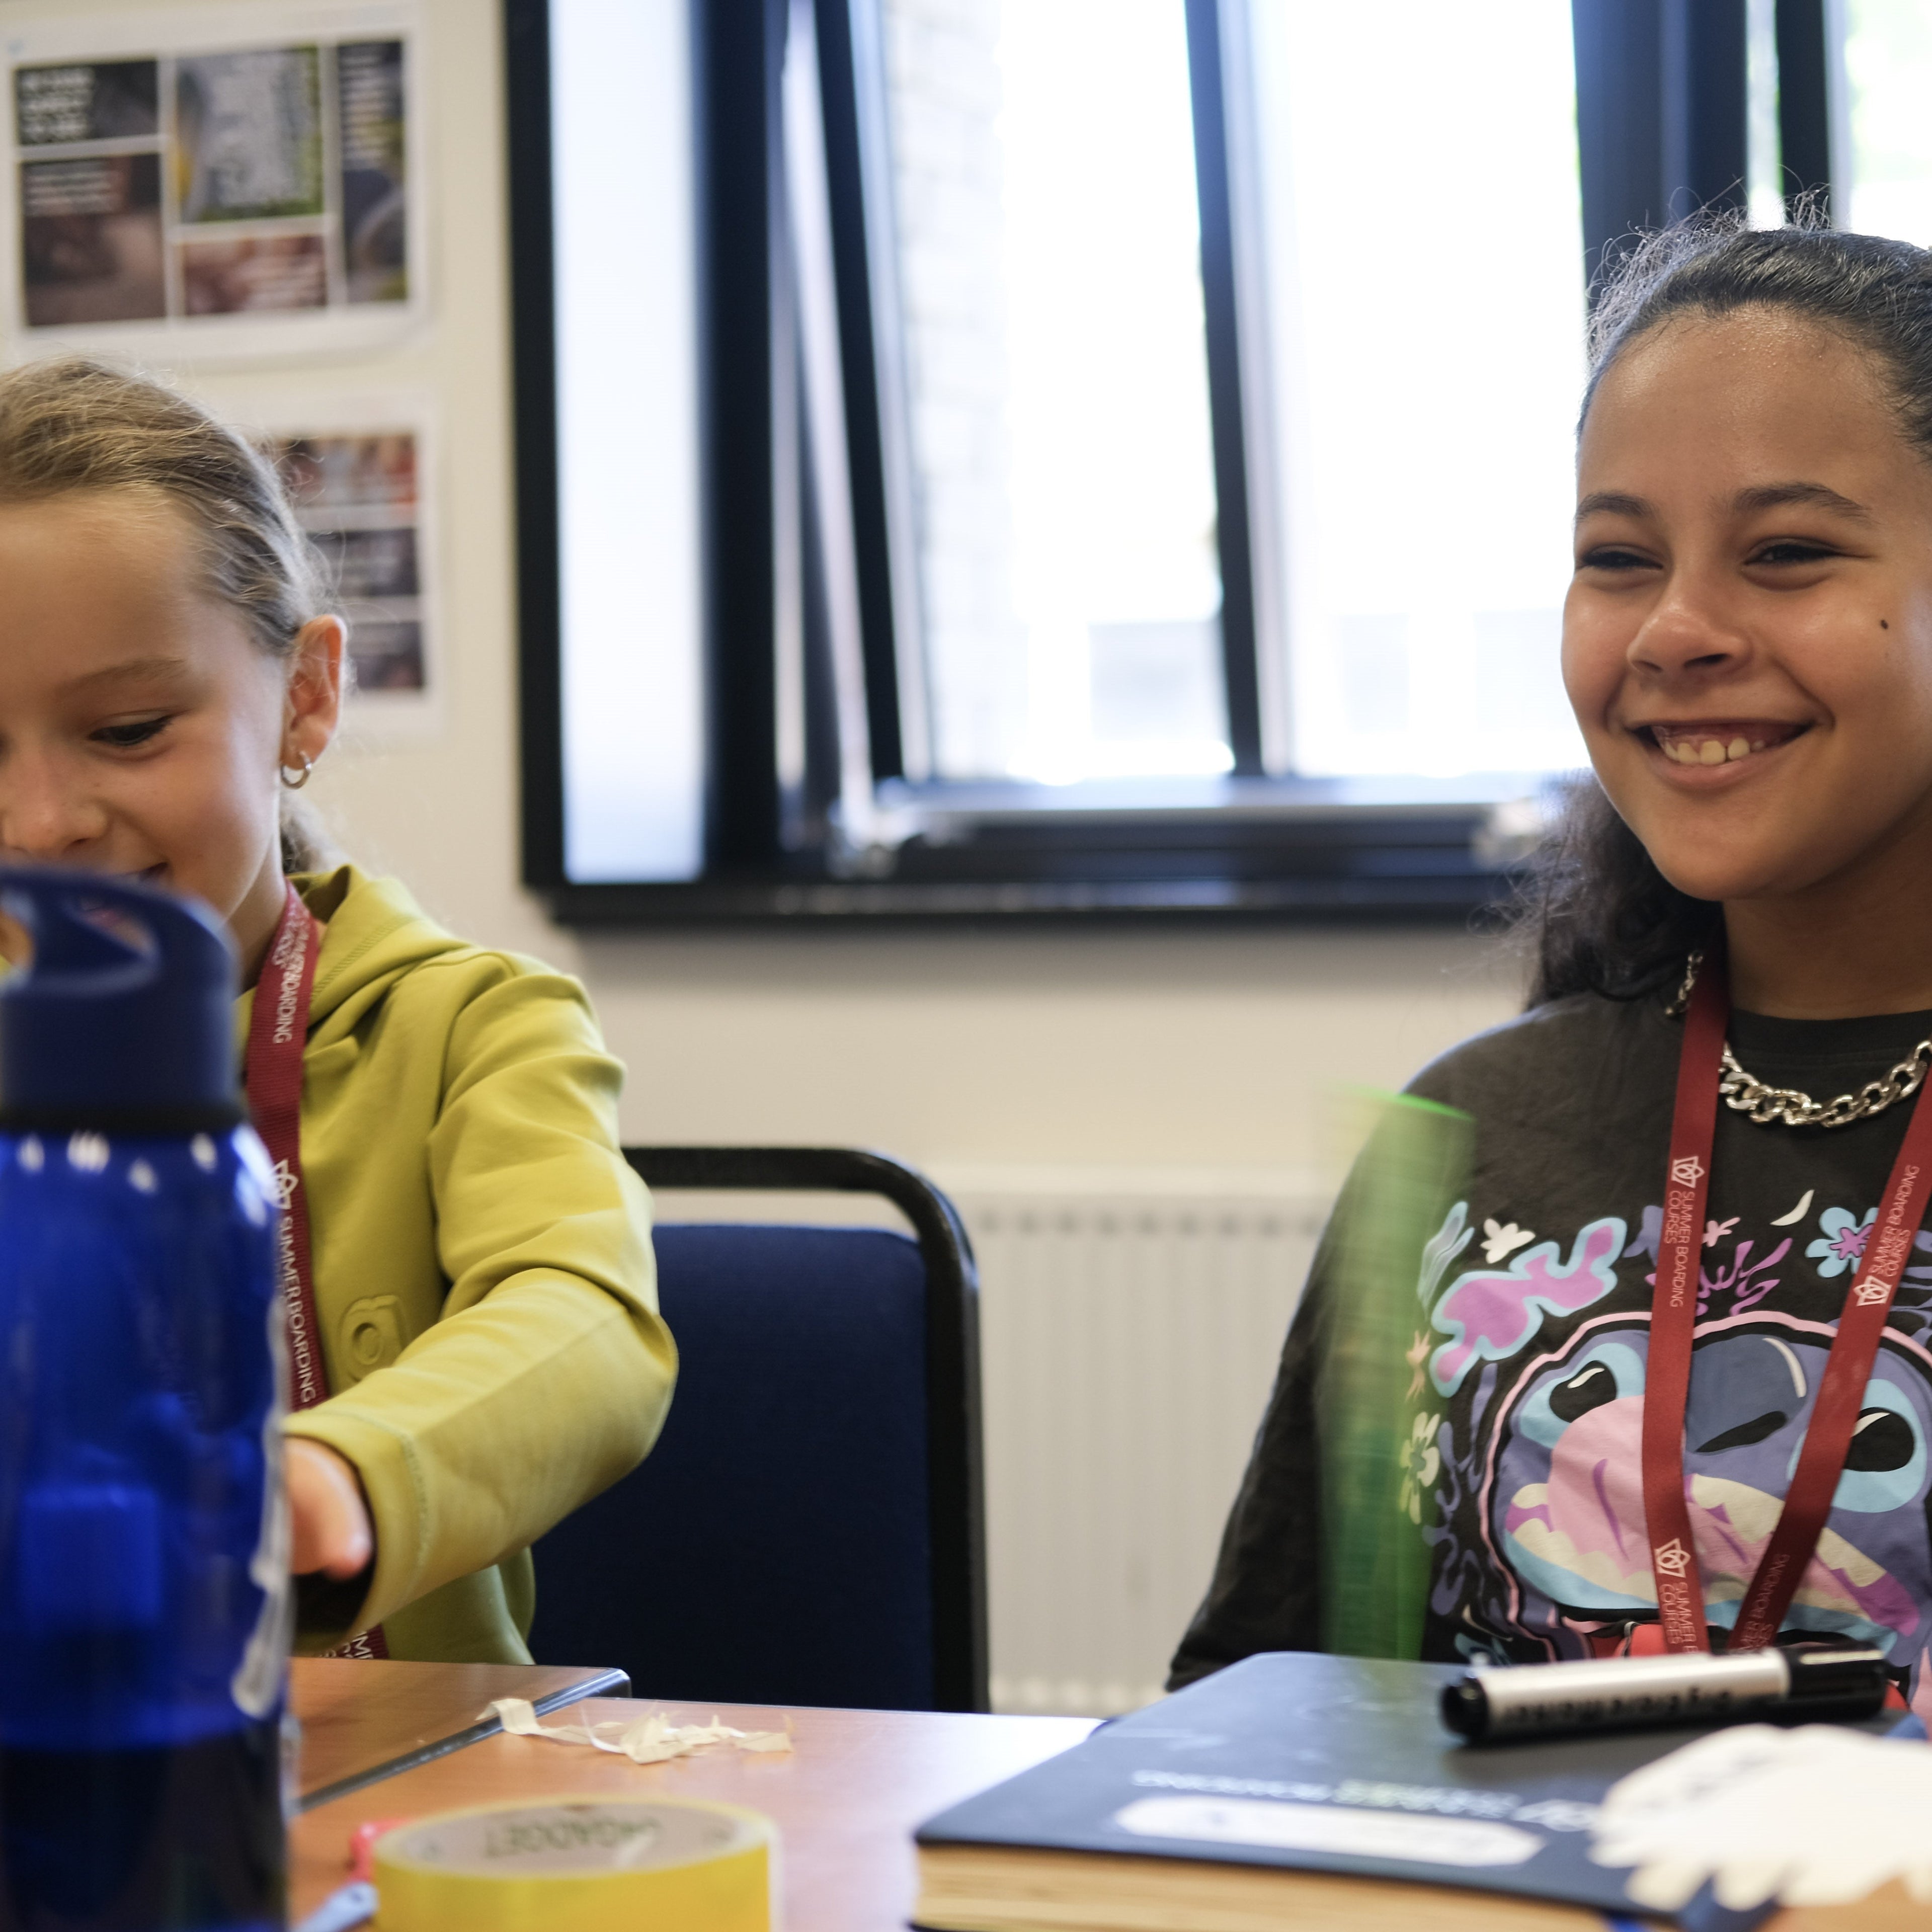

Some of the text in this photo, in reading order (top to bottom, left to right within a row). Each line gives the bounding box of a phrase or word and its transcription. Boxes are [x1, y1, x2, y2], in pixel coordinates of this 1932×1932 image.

[1663, 1190, 1681, 1245] COURSES
[1669, 1191, 1695, 1308] SUMMER BOARDING
[1868, 1165, 1920, 1275] SUMMER BOARDING
[278, 1216, 302, 1302] SUMMER
[1884, 1228, 1911, 1277] COURSES
[287, 1300, 316, 1404] BOARDING
[1659, 1583, 1683, 1645] COURSES
[1672, 1581, 1697, 1643] SUMMER
[1747, 1553, 1791, 1620] BOARDING
